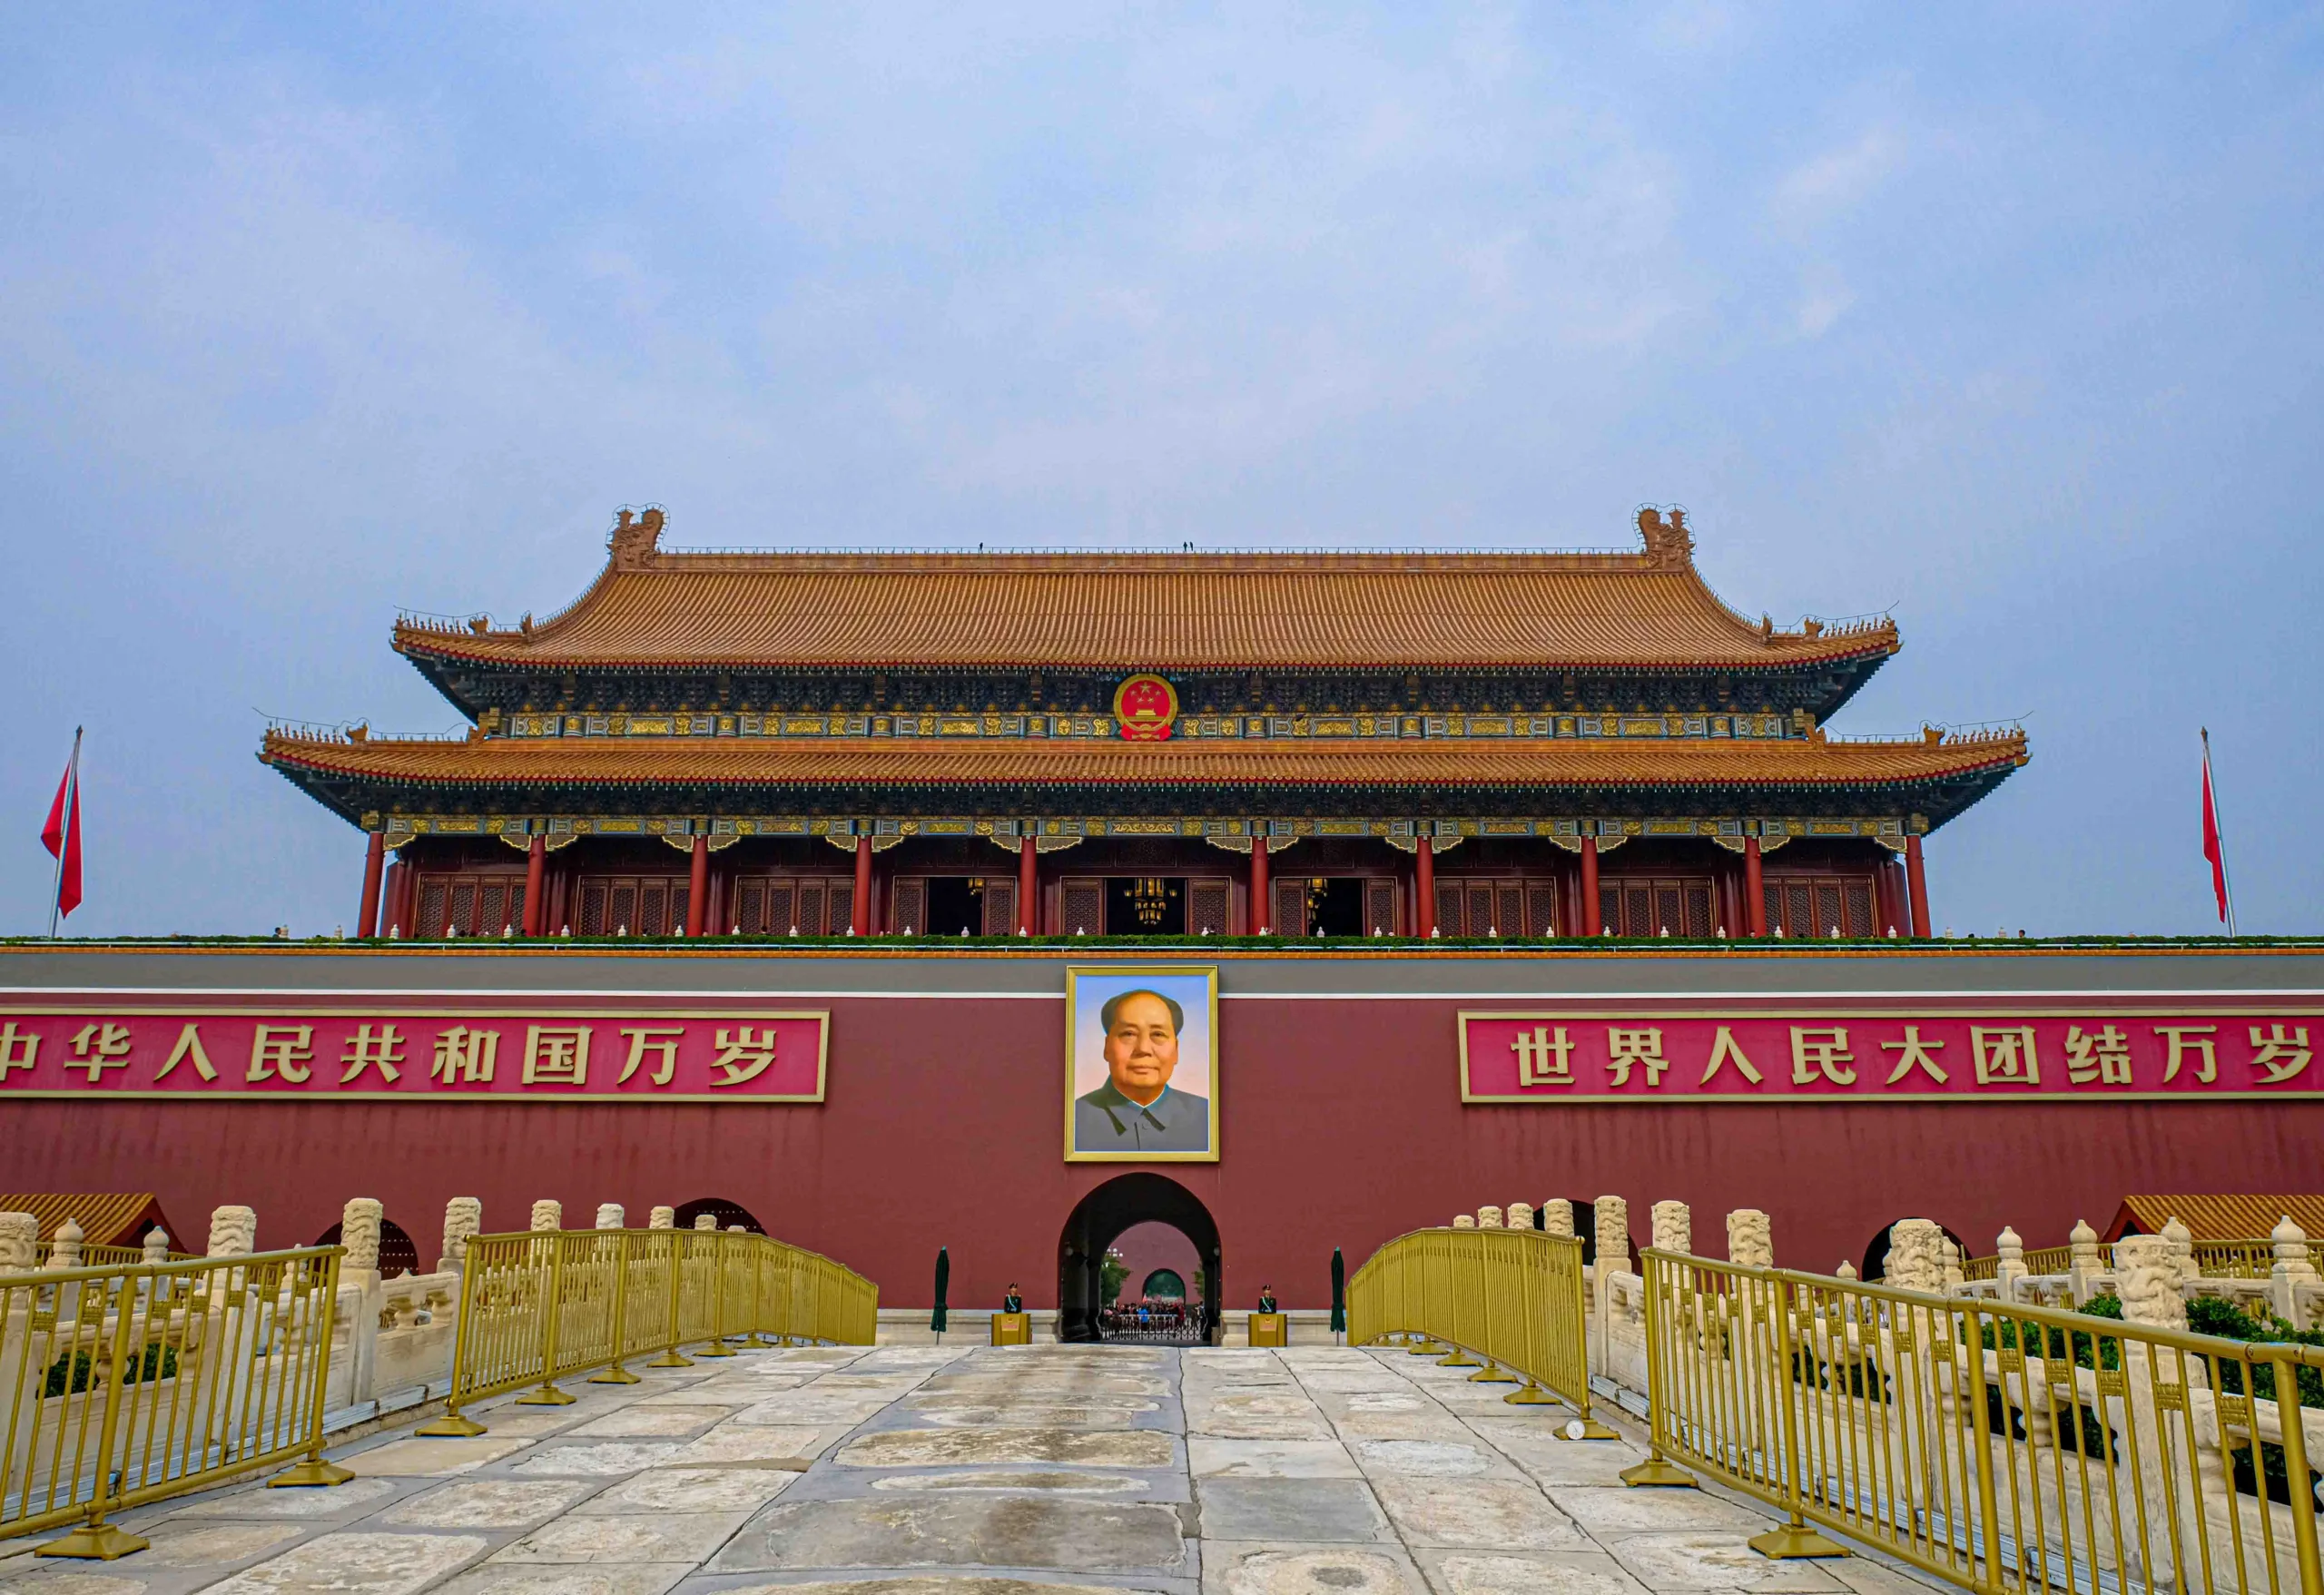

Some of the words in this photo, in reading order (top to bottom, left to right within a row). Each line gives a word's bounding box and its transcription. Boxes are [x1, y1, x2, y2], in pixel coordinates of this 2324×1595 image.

[0, 1022, 776, 1087] 中华人民共和国万岁
[1510, 1023, 2314, 1087] 世界人民大团结万岁
